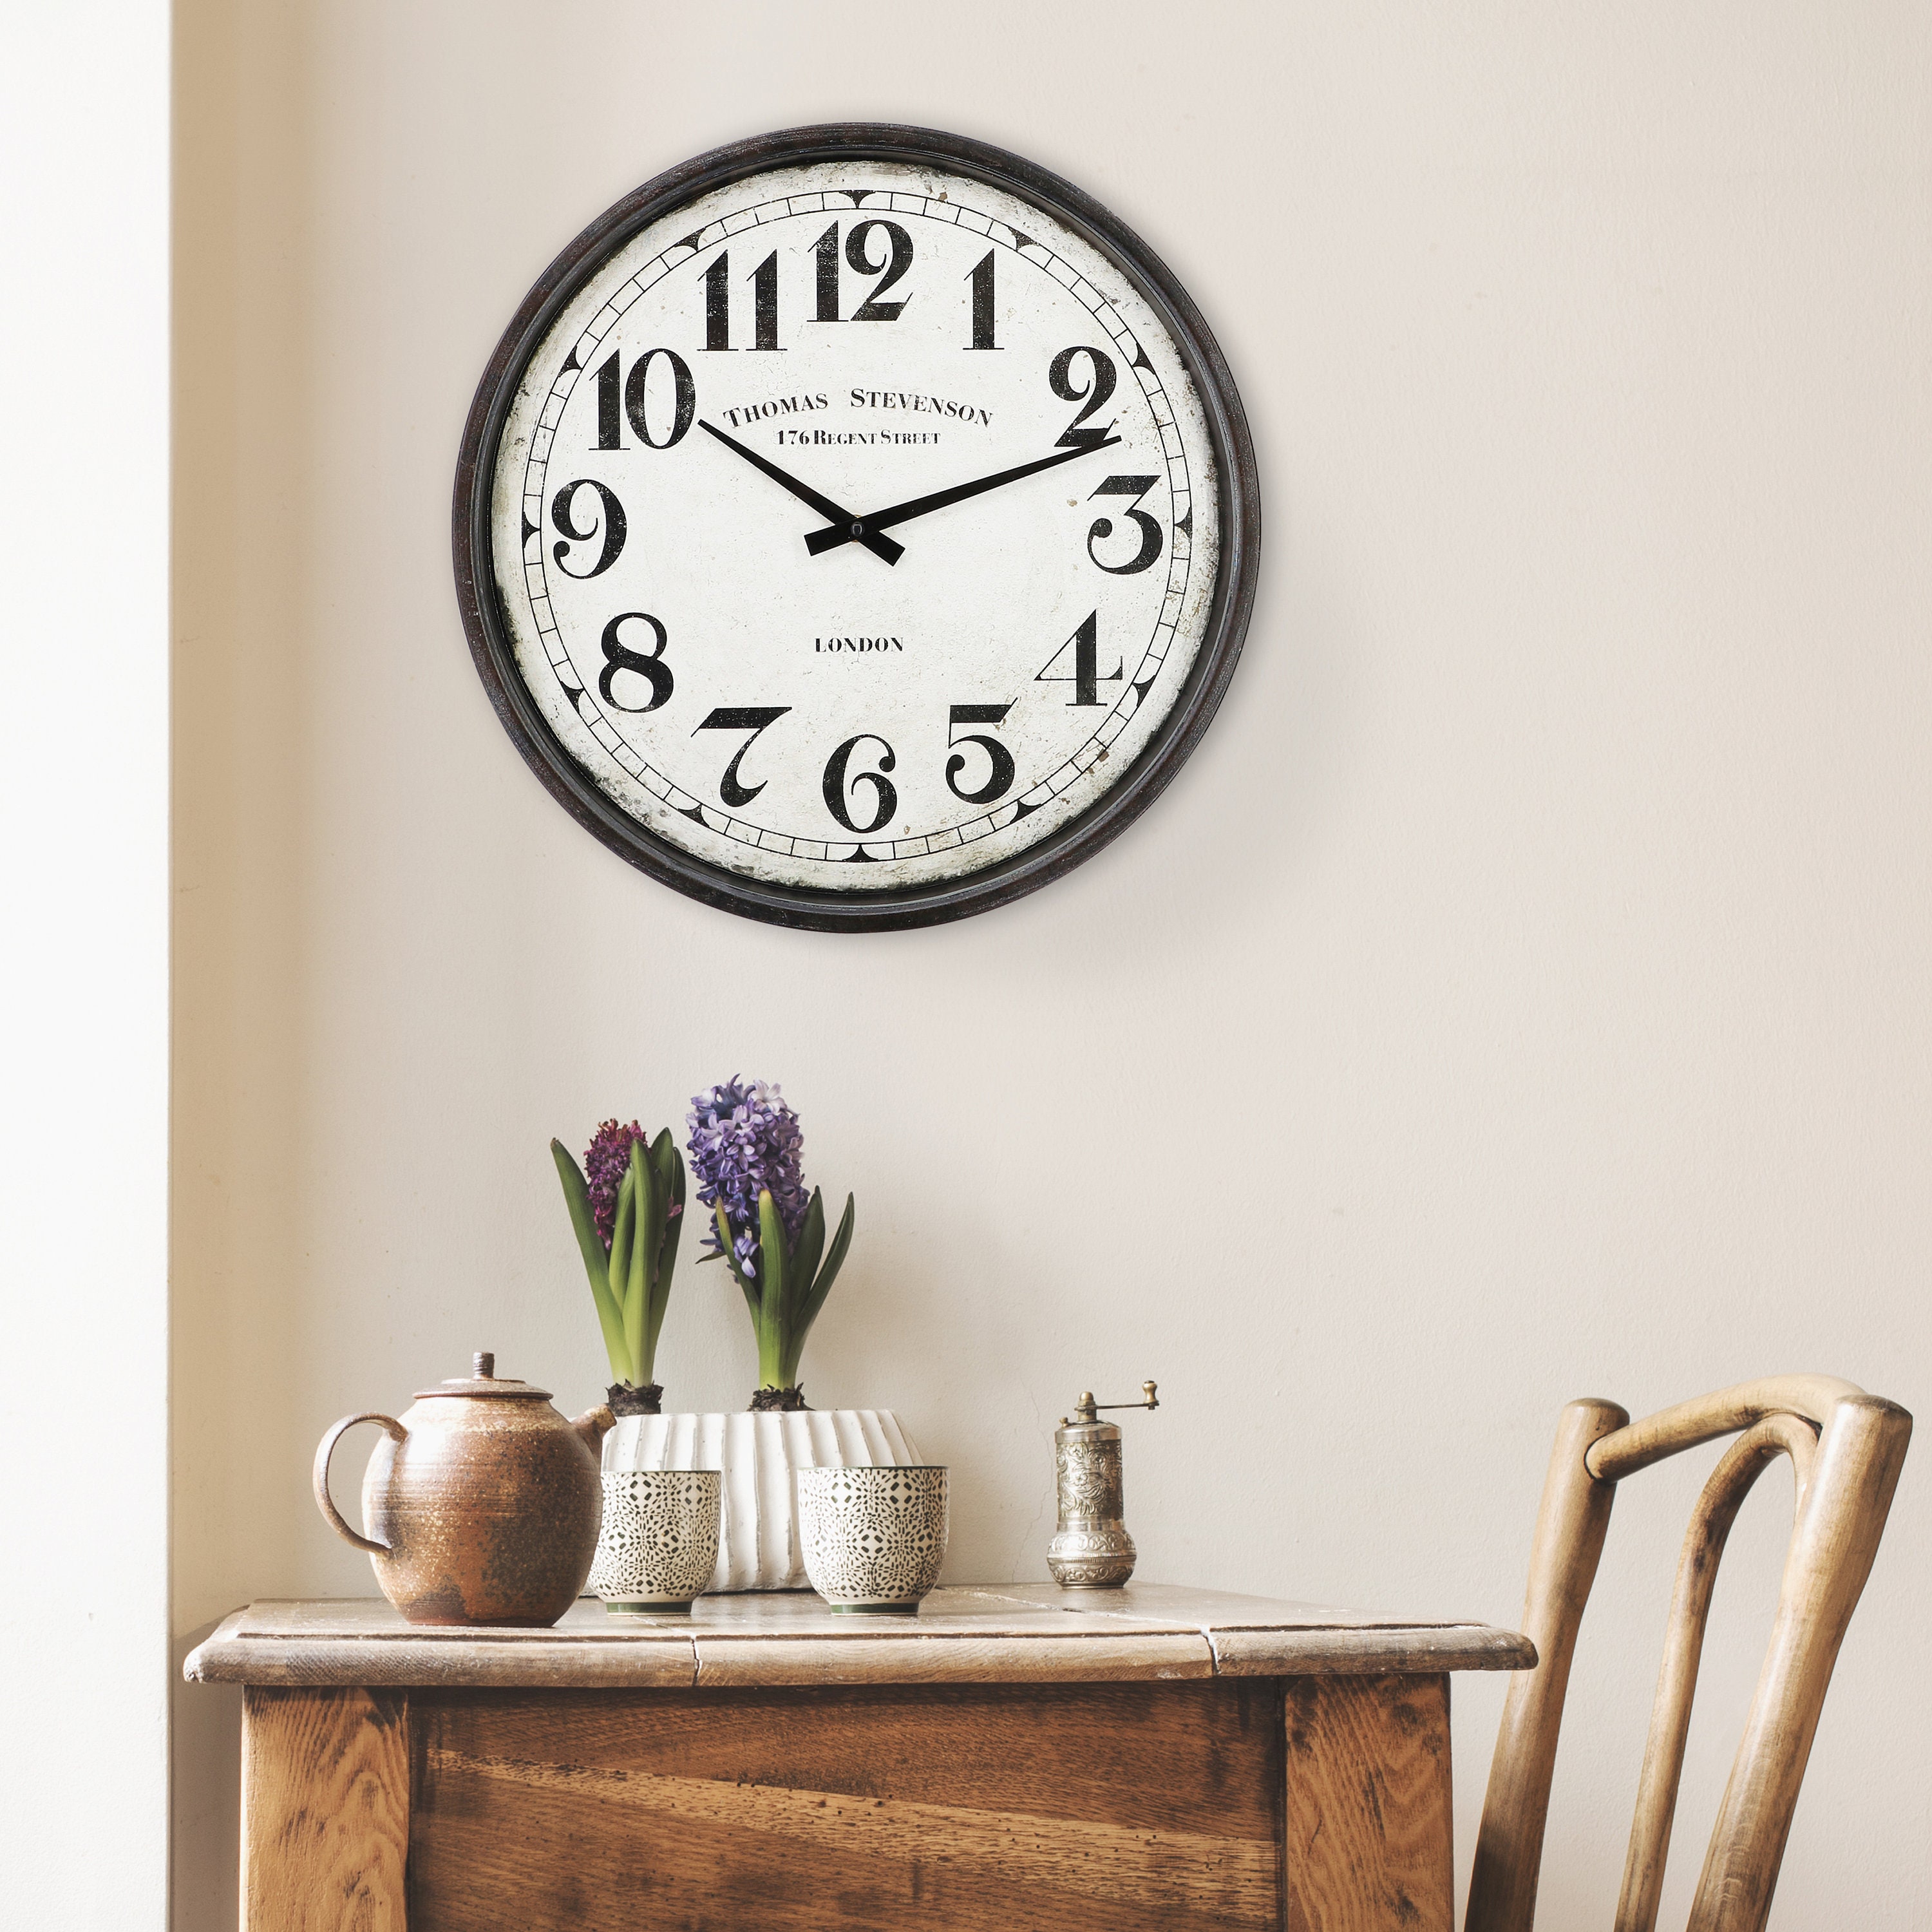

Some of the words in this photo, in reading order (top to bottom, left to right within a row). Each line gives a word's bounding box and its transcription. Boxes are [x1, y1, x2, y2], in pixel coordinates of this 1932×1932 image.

[697, 249, 787, 352] 11
[807, 220, 913, 323] 12
[961, 249, 1005, 351] 1
[589, 348, 696, 450] 10
[723, 393, 828, 428] THOMAS
[850, 388, 994, 428] STEVENSON
[777, 430, 810, 445] 176
[813, 430, 877, 444] REGENT
[880, 429, 941, 444] STREET
[1049, 346, 1117, 448] 2
[552, 478, 628, 579] 9
[1086, 475, 1164, 575] 3
[599, 612, 674, 714] 8
[815, 637, 904, 652] LONDON
[1034, 609, 1123, 706] 4
[691, 706, 793, 808] 7
[822, 734, 898, 834] 6
[946, 697, 1019, 805] 5
